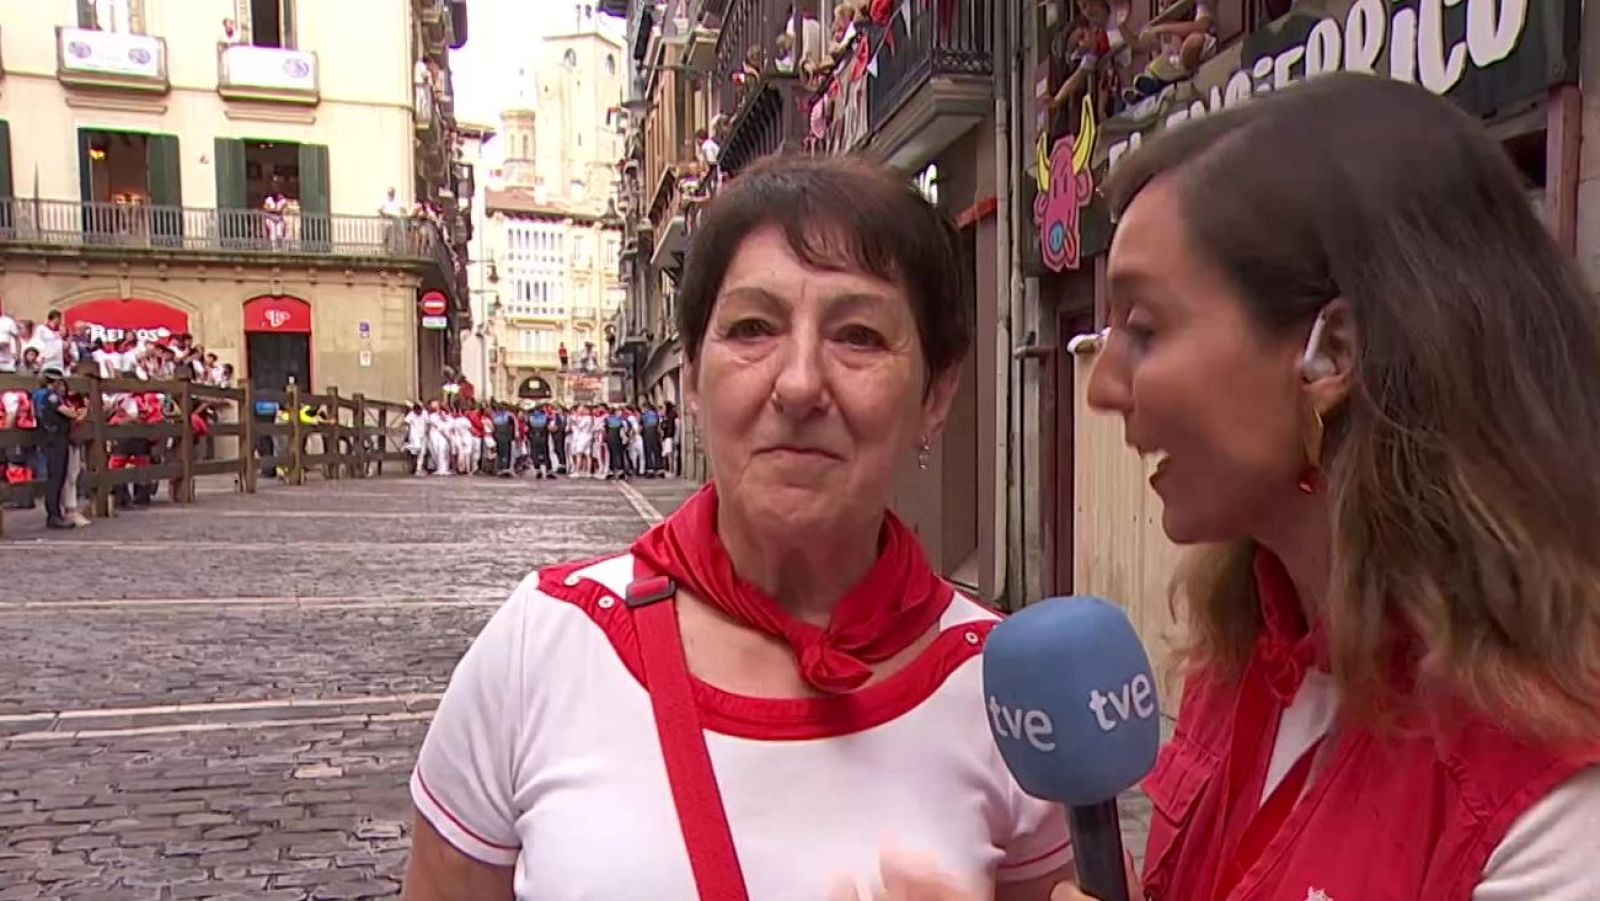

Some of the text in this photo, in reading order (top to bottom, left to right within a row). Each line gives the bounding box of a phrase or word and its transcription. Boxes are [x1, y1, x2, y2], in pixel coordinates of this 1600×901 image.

[90, 325, 158, 344] REIOS
[988, 696, 1056, 752] tve
[1089, 673, 1154, 731] tve
